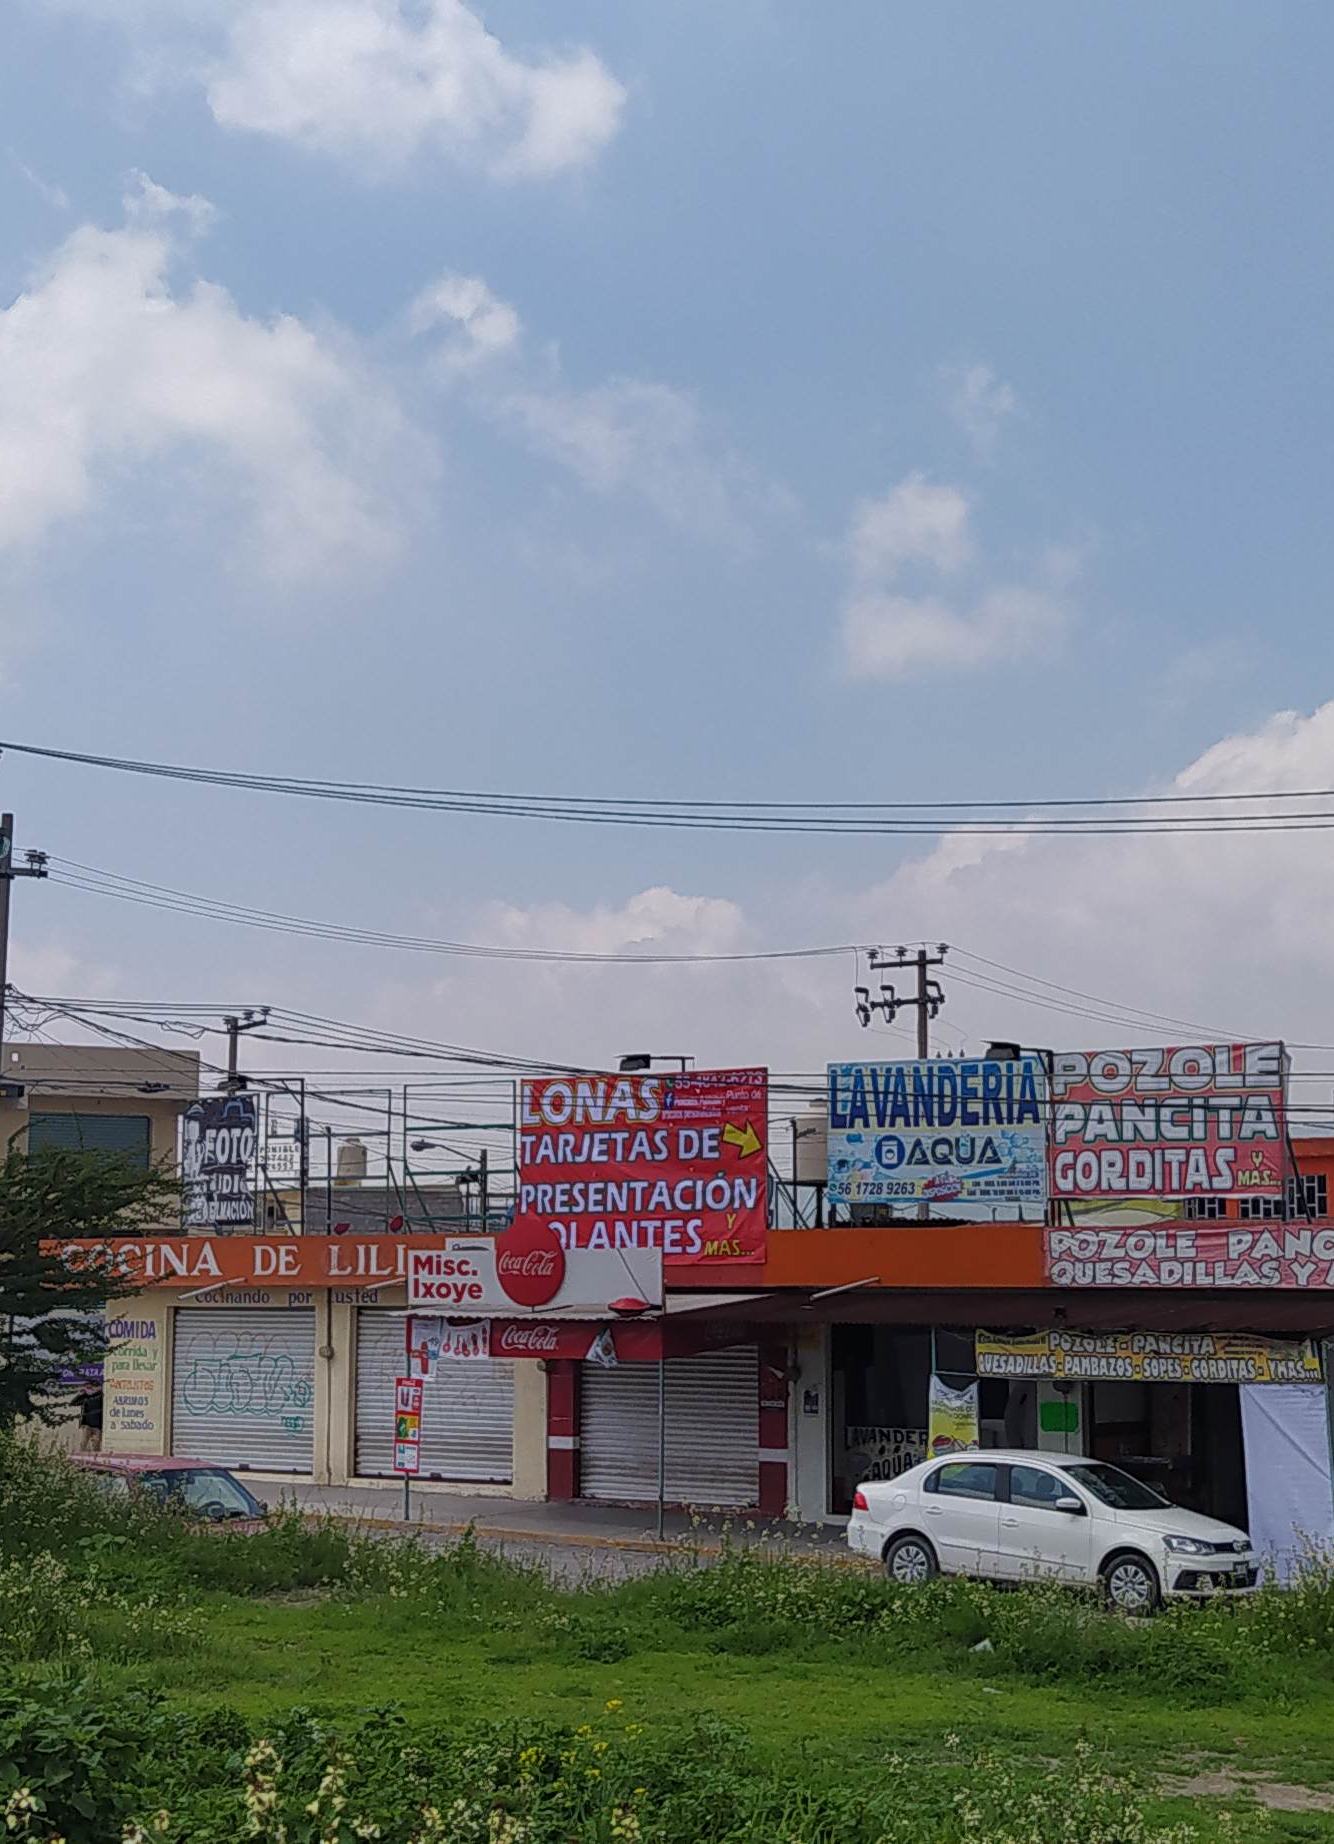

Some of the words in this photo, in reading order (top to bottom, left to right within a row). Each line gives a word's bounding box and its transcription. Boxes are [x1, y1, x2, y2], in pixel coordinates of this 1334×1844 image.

[1054, 1043, 1281, 1096] POZOLE
[522, 1078, 660, 1125] LONAS
[831, 1061, 1040, 1129] LAVANDERIA
[1054, 1094, 1279, 1144] PANCITA
[204, 1127, 254, 1164] FOTO
[520, 1130, 668, 1164] TARJETAS
[678, 1127, 720, 1160] DE
[906, 1136, 1002, 1166] AQUA
[1055, 1148, 1235, 1192] GORDITAS
[1251, 1152, 1264, 1168] Y
[520, 1171, 758, 1214] PRESENTACIÓN
[837, 1181, 852, 1196] 56
[856, 1181, 883, 1196] 1728
[885, 1181, 916, 1196] 9263
[725, 1213, 737, 1230] Y
[1049, 1228, 1197, 1259] POZOLE
[60, 1241, 223, 1277] COCINA
[252, 1244, 300, 1277] DE
[328, 1243, 406, 1277] LILI
[413, 1254, 479, 1276] Misc.
[1050, 1260, 1280, 1287] QUESADILLAS
[1290, 1261, 1316, 1287] Y
[288, 1289, 313, 1306] por
[333, 1287, 379, 1304] usted
[413, 1279, 484, 1303] Ixoye
[108, 1320, 156, 1339] COMIDA
[1049, 1331, 1116, 1353] POZOLE
[1132, 1333, 1215, 1354] PANCITA
[1065, 1355, 1133, 1376] PAMBAZOS
[1142, 1357, 1182, 1378] SOPES
[1191, 1358, 1256, 1379] GORDITAS
[109, 1408, 121, 1418] de
